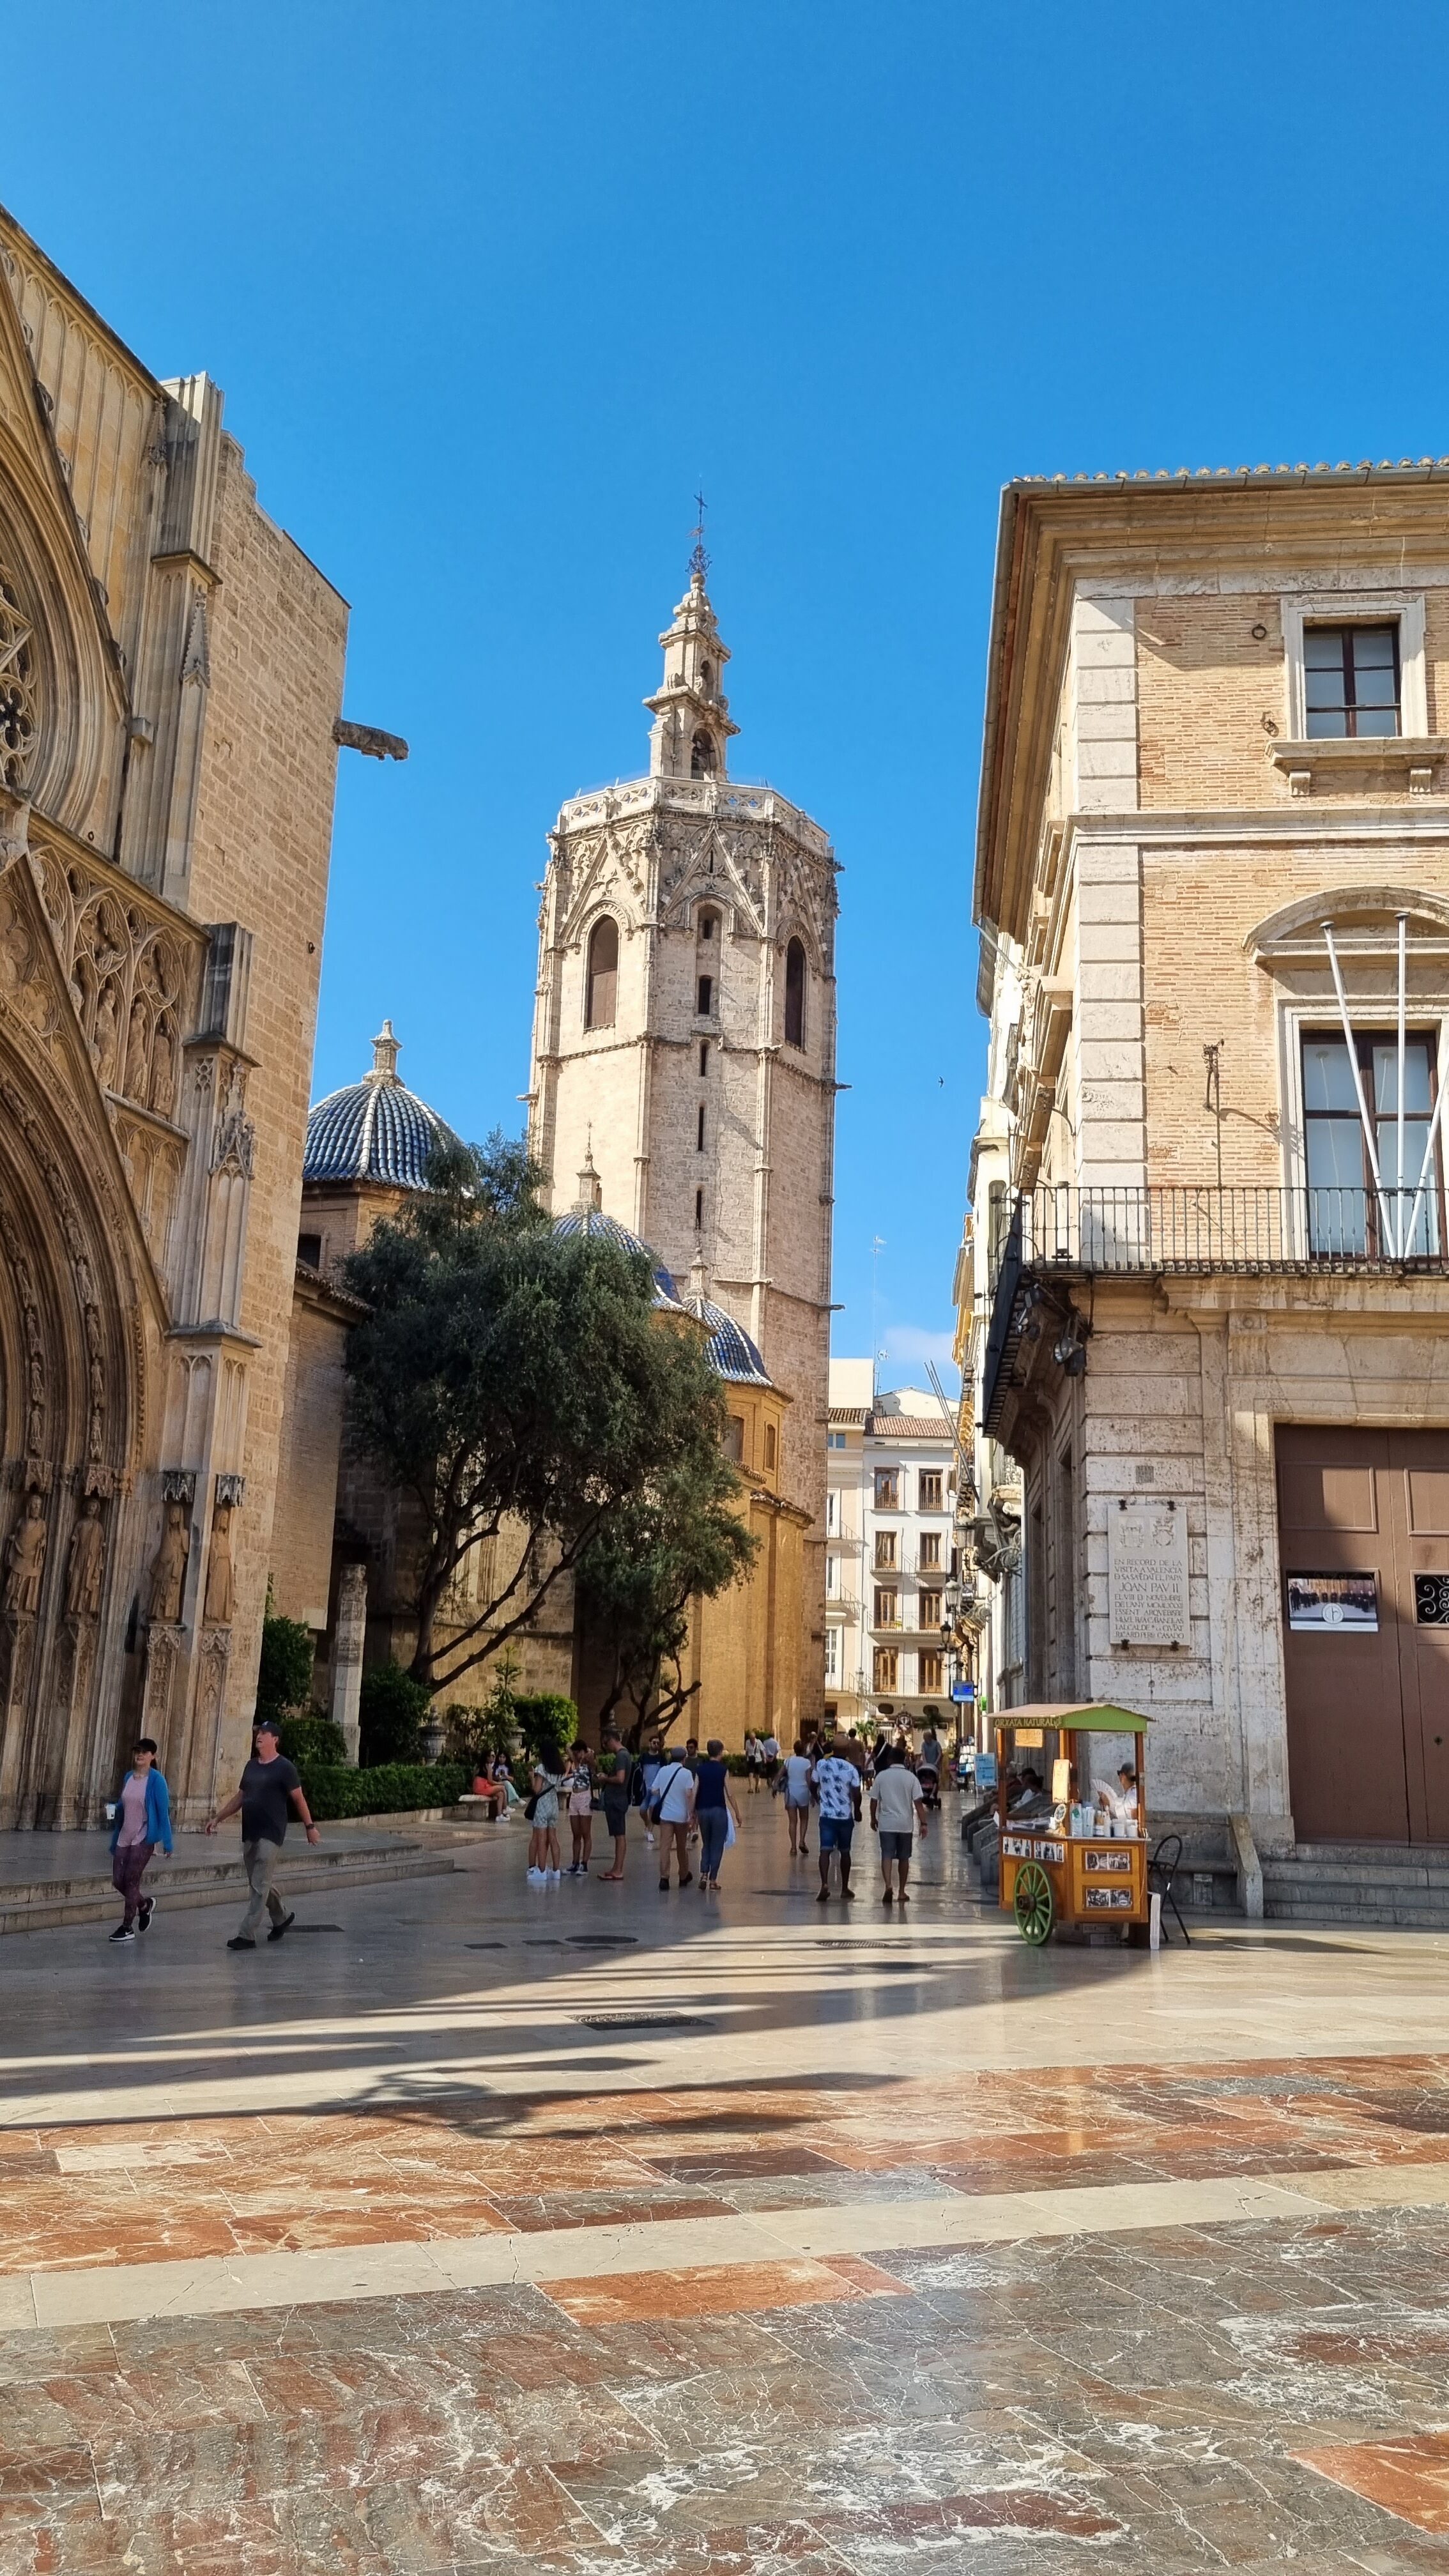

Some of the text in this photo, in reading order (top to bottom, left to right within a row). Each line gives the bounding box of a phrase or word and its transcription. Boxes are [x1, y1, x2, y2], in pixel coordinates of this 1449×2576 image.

[1119, 1582, 1147, 1591] JOAN
[995, 1717, 1054, 1727] ORXATA NATURAL
